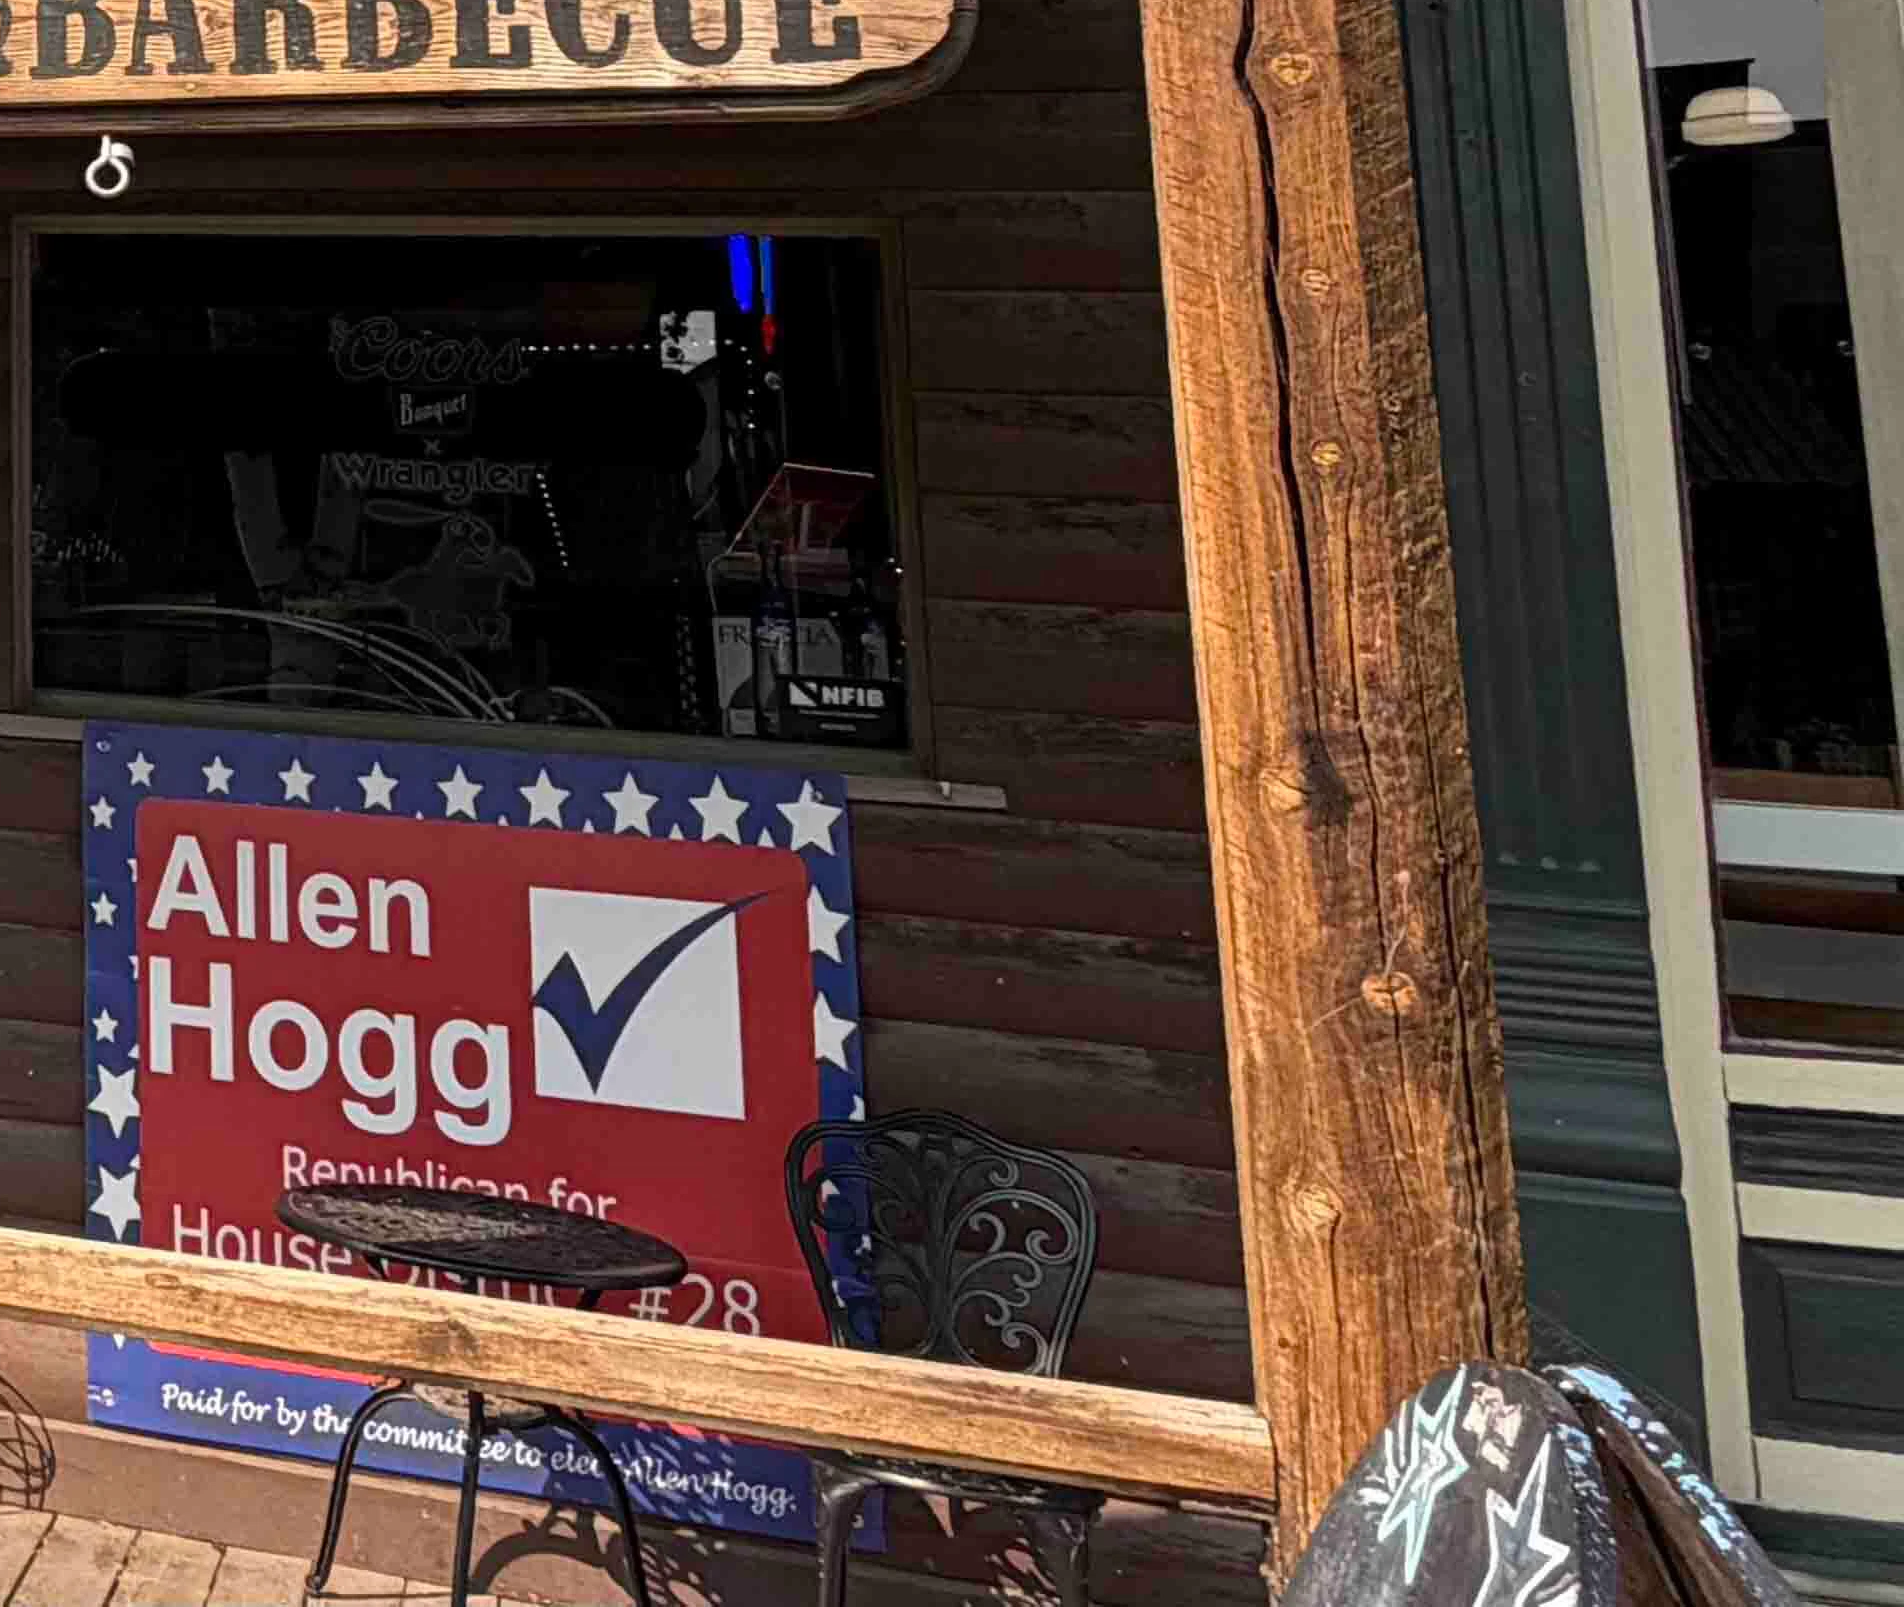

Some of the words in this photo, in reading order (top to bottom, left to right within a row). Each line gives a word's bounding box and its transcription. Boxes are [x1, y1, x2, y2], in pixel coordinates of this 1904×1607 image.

[329, 312, 522, 386] Coors
[331, 449, 537, 506] Wrangler
[821, 685, 886, 707] NFIB
[146, 833, 432, 957] Allen
[147, 955, 512, 1147] Hogg
[549, 1177, 617, 1220] for
[160, 1382, 228, 1418] Paid
[229, 1386, 271, 1425] for
[276, 1396, 307, 1436] by
[363, 1417, 509, 1464] commitee
[513, 1437, 542, 1468] to
